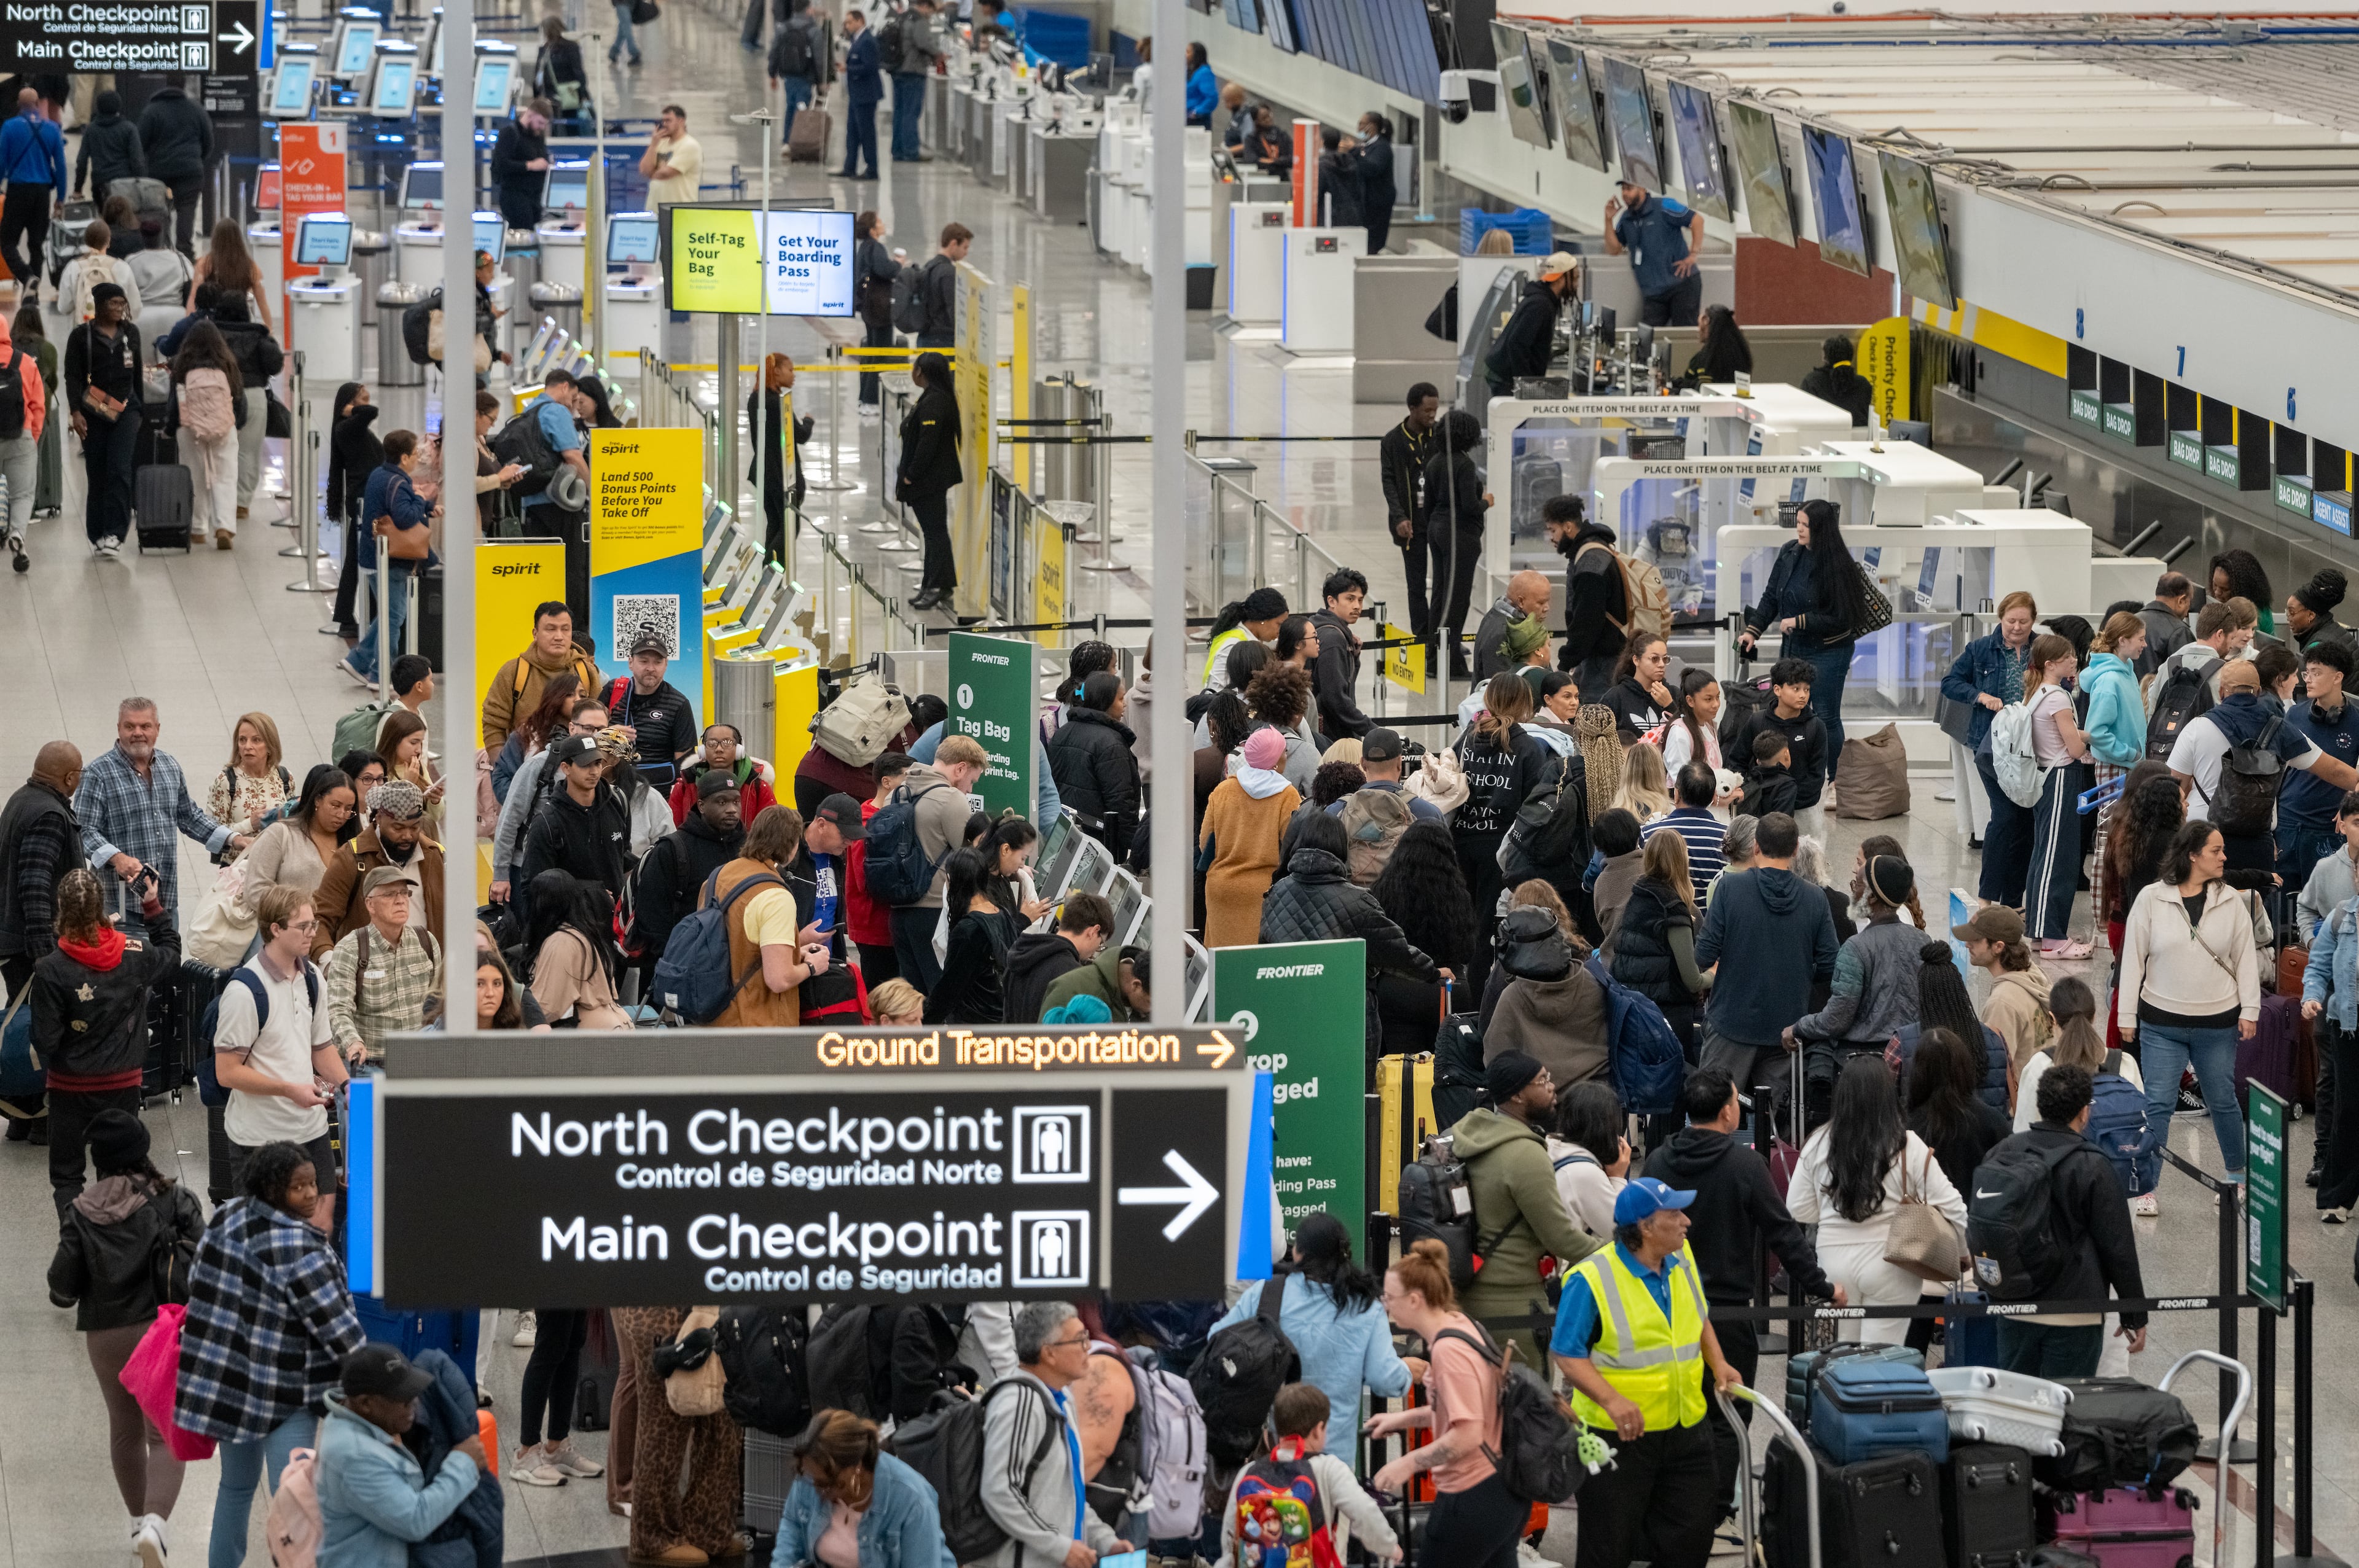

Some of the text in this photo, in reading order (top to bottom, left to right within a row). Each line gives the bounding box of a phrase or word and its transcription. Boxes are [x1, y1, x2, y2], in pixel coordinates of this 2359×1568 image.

[7, 4, 179, 23] North Checkpoint
[43, 22, 179, 34] Control de Seguridad Norte
[17, 40, 179, 60] Main Checkpoint
[74, 59, 179, 71] Control de Seguridad
[329, 131, 337, 147] 1
[285, 192, 343, 202] TAG YOUR BAG
[689, 233, 745, 248] Self-Tag
[778, 236, 839, 249] Get Your
[689, 248, 721, 259] Your
[778, 251, 842, 266] Boarding
[689, 262, 715, 276] Bag
[778, 265, 810, 277] Pass
[2076, 308, 2084, 339] 8
[1883, 337, 1896, 386] Priority
[2177, 345, 2185, 377] 7
[2073, 398, 2098, 422] BAG DROP
[2287, 387, 2296, 421] 6
[2106, 412, 2131, 436] BAG DROP
[601, 444, 640, 456] spirit
[2173, 439, 2200, 465] BAG DROP
[2209, 455, 2236, 480] BAG DROP
[601, 472, 653, 482] Land 500
[601, 483, 676, 493] Bonus Points
[601, 495, 663, 505] Before You
[2279, 483, 2307, 510] BAG DROP
[601, 507, 650, 518] Take Off
[2315, 500, 2349, 530] AGENT ASSIST
[492, 563, 542, 577] spirit
[1043, 561, 1060, 591] spirit
[971, 652, 1010, 666] FRONTIER
[1392, 663, 1414, 682] NO ENTRY
[957, 716, 1011, 742] Tag Bag
[1498, 752, 1517, 766] IN
[985, 768, 1020, 780] print tag.
[1465, 770, 1513, 790] SCHOOL
[1256, 964, 1324, 980] FRONTIER
[816, 1029, 1180, 1071] Ground Transportation
[1247, 1053, 1288, 1073] rop
[512, 1106, 1004, 1163] North Checkpoint
[1276, 1155, 1312, 1168] have:
[616, 1160, 1003, 1191] Control de Seguridad Norte
[1307, 1176, 1337, 1191] Pass
[542, 1211, 1003, 1267] Main Checkpoint
[704, 1260, 1003, 1293] Control de Seguridad
[1986, 1303, 2038, 1315] FRONTIER
[2157, 1298, 2208, 1309] FRONTIER
[1814, 1307, 1866, 1318] FRONTIER
